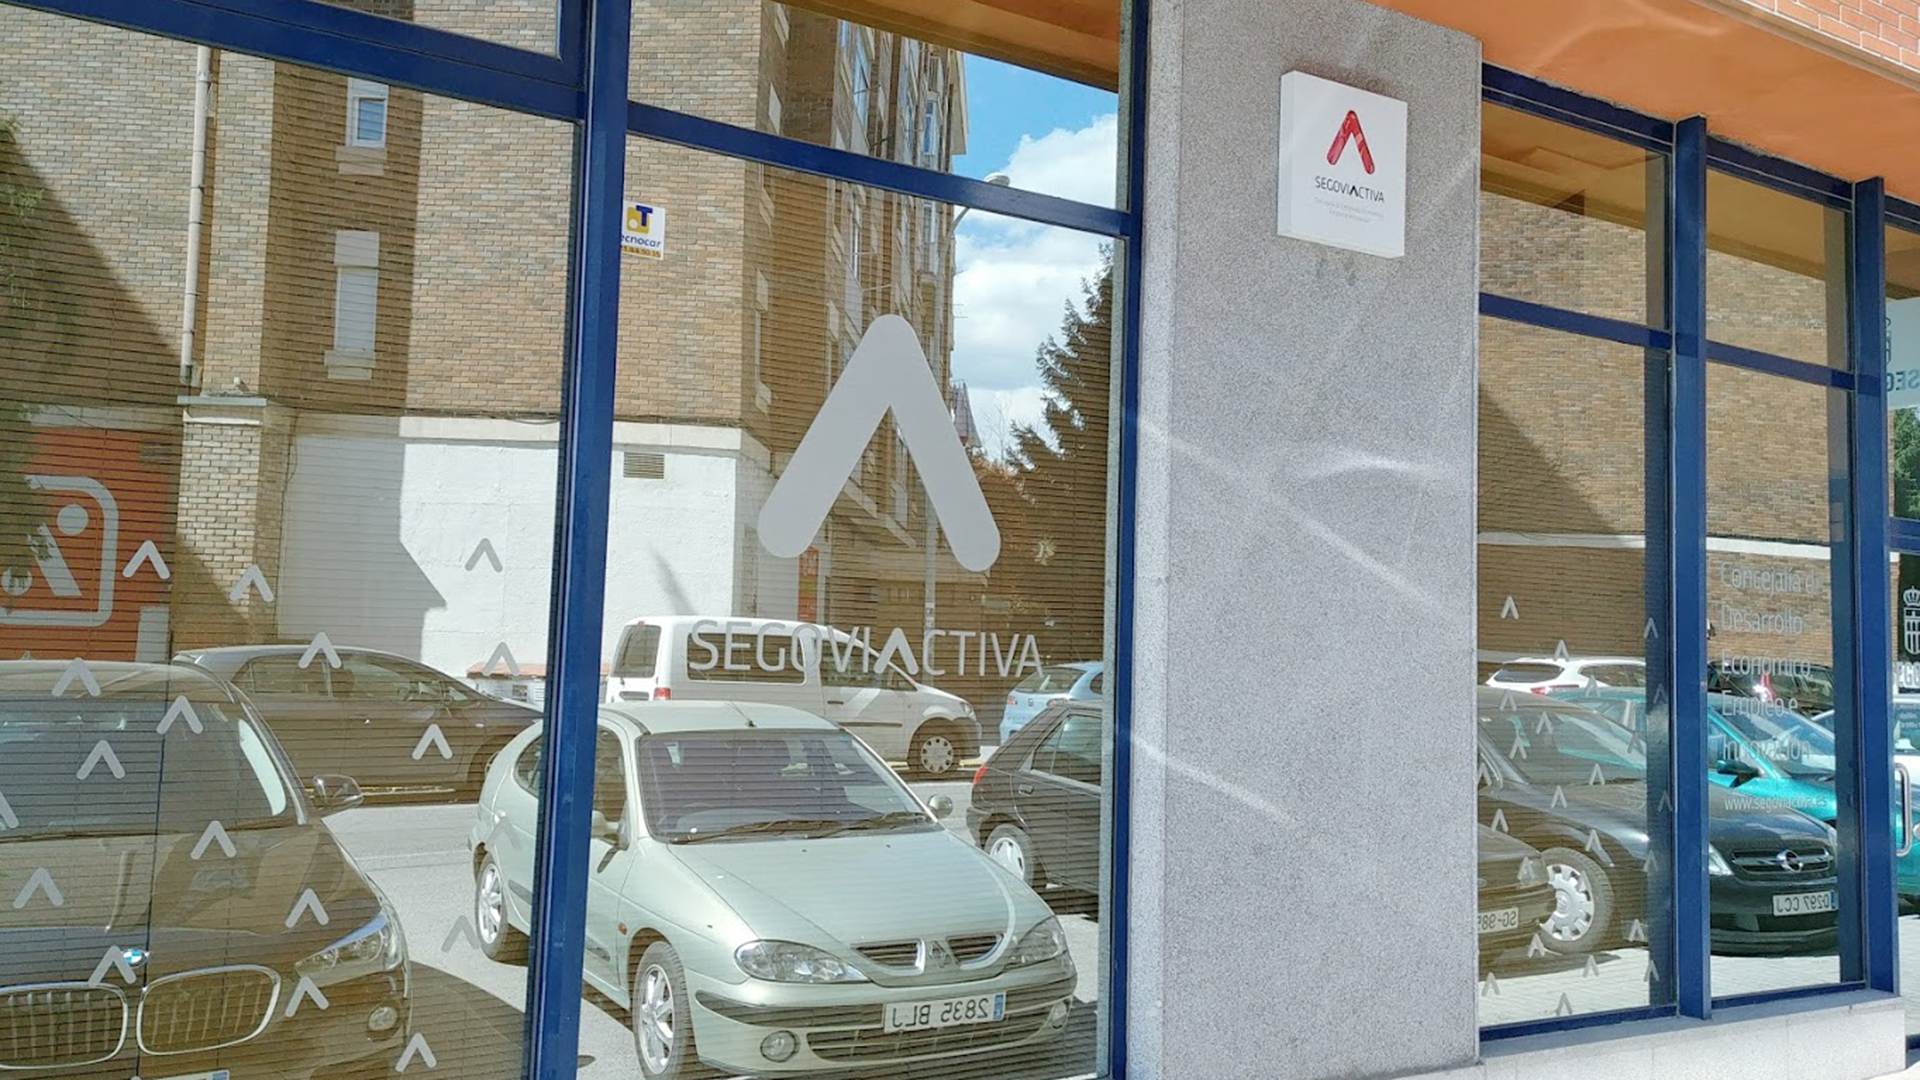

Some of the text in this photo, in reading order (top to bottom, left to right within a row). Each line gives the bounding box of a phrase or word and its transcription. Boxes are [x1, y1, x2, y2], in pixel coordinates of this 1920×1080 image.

[1314, 175, 1385, 203] SEGOVIACTIVA
[621, 234, 661, 248] ecnocar
[1722, 603, 1803, 635] Desarrollo
[689, 618, 1044, 678] SEGOVIACTIVA
[1722, 690, 1799, 723] Empleo e
